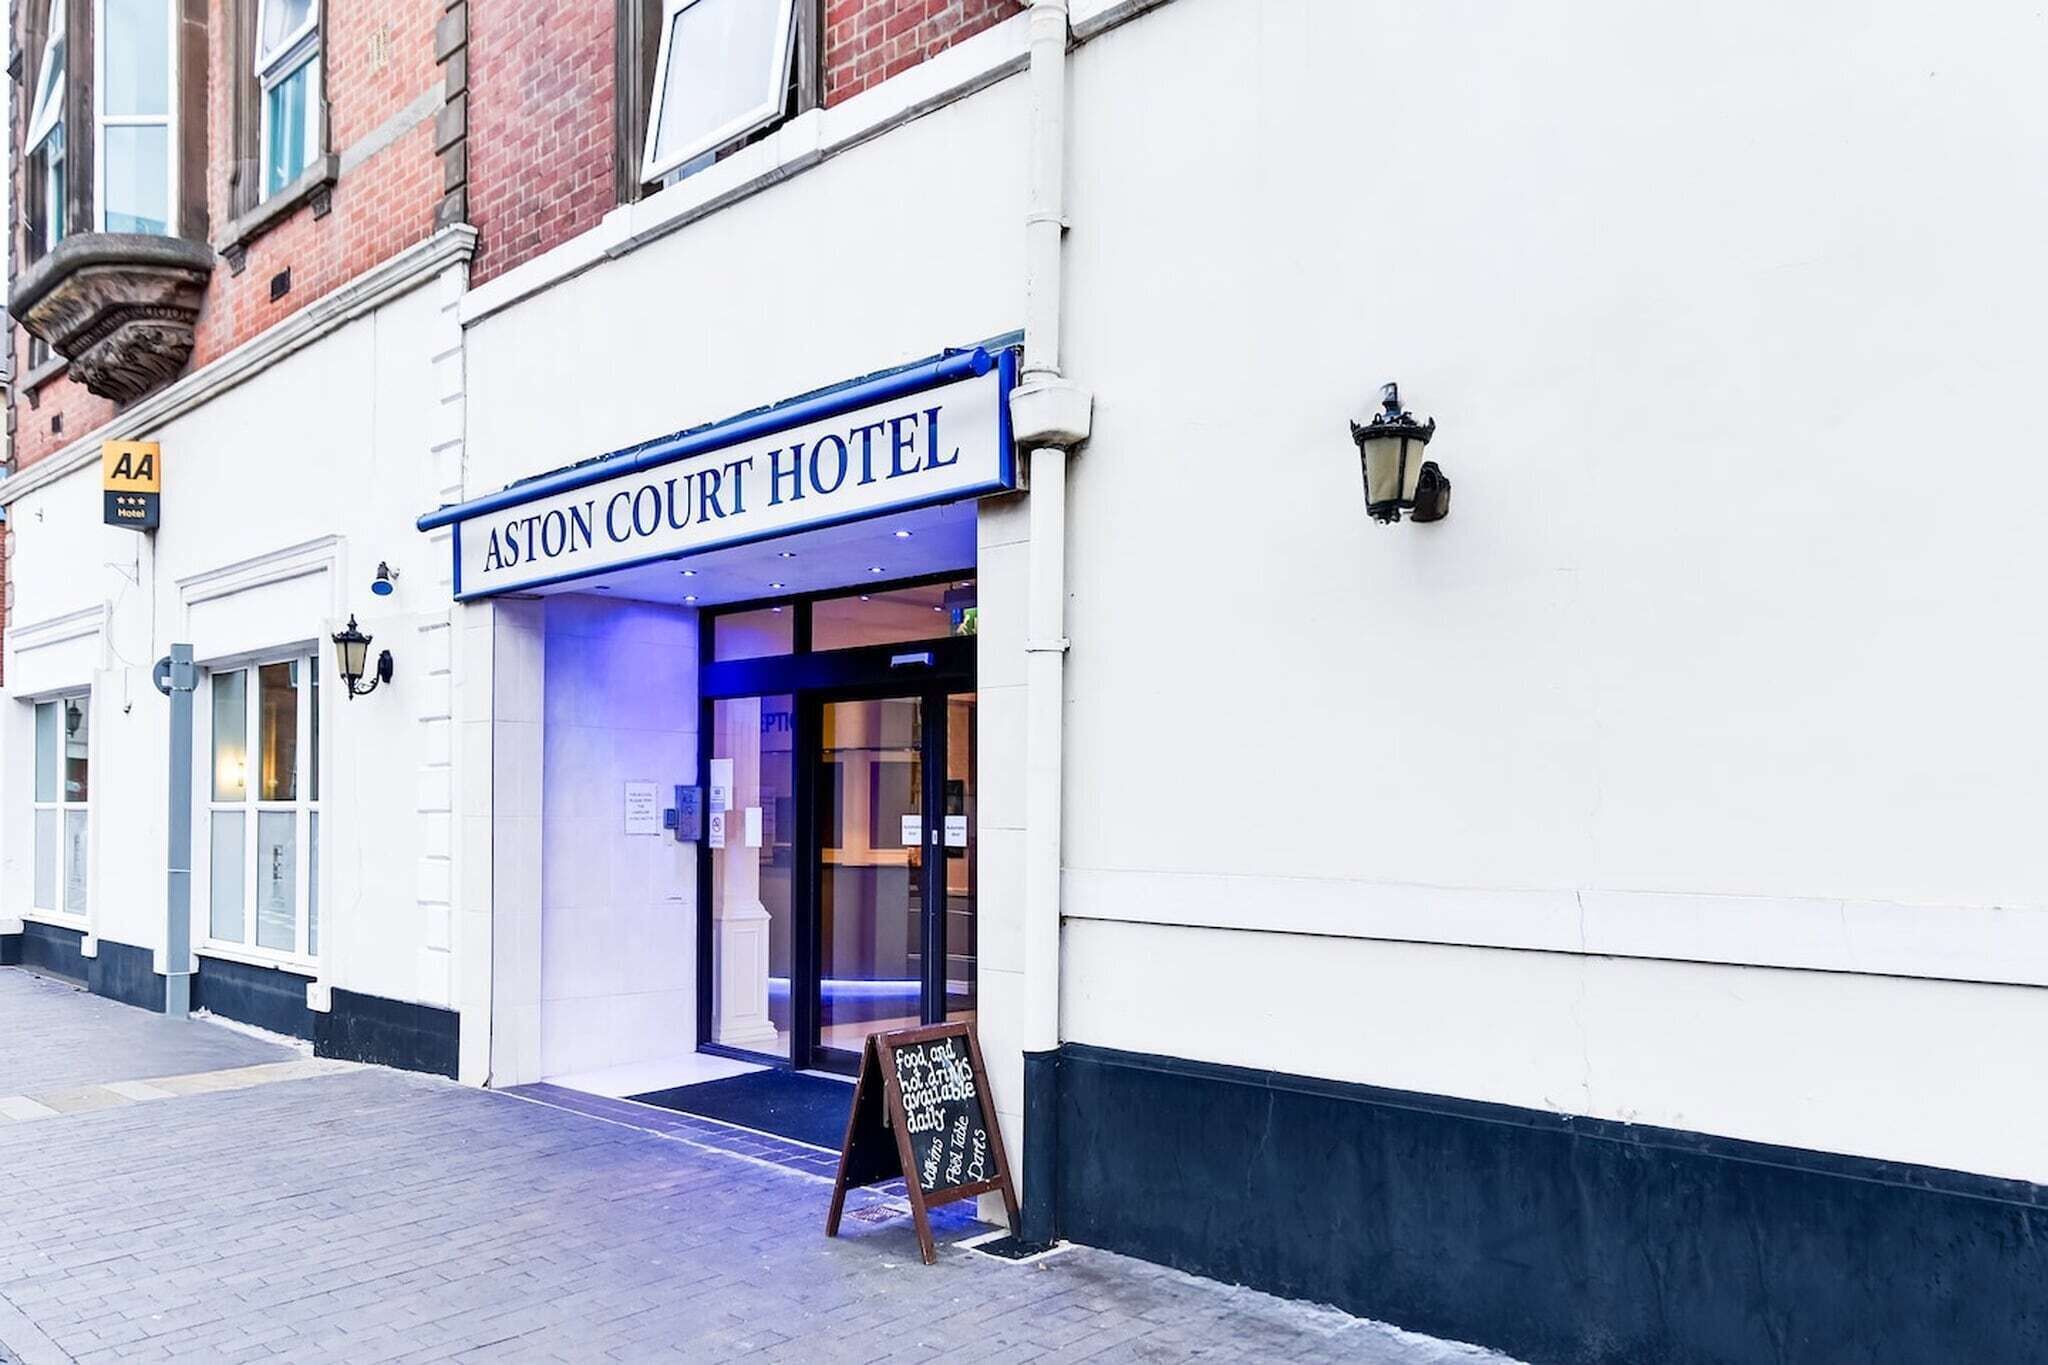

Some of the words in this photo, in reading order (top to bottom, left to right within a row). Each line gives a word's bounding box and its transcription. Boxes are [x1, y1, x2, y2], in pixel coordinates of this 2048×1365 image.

[111, 453, 153, 480] AA
[484, 500, 595, 572] ASTON
[606, 456, 753, 543] COURT
[768, 406, 959, 507] HOTEL
[117, 508, 145, 518] Hotel
[896, 1045, 927, 1071] food
[930, 1037, 956, 1062] and
[896, 1067, 923, 1093] hot
[903, 1082, 976, 1111] available
[907, 1105, 946, 1133] daily
[951, 1115, 969, 1149] Table
[967, 1129, 986, 1181] Darts
